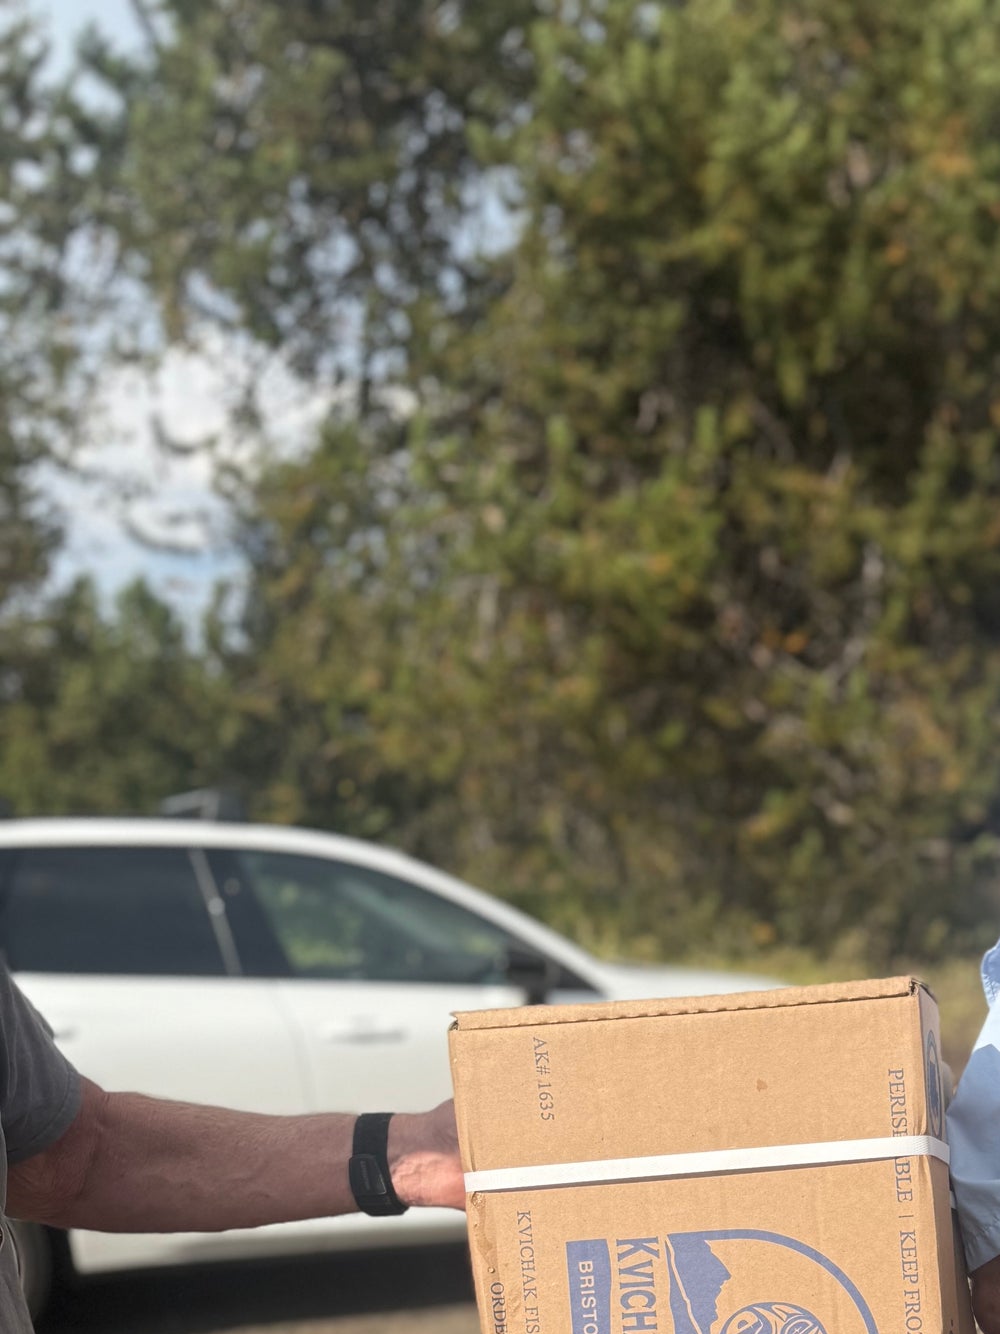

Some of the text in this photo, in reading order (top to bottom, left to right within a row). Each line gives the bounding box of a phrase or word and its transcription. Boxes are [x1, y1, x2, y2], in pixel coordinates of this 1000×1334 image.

[533, 1036, 555, 1121] AK# 1635
[888, 1067, 914, 1203] PERISBLE
[516, 1210, 538, 1301] KVICHAK
[900, 1230, 919, 1284] KEEP
